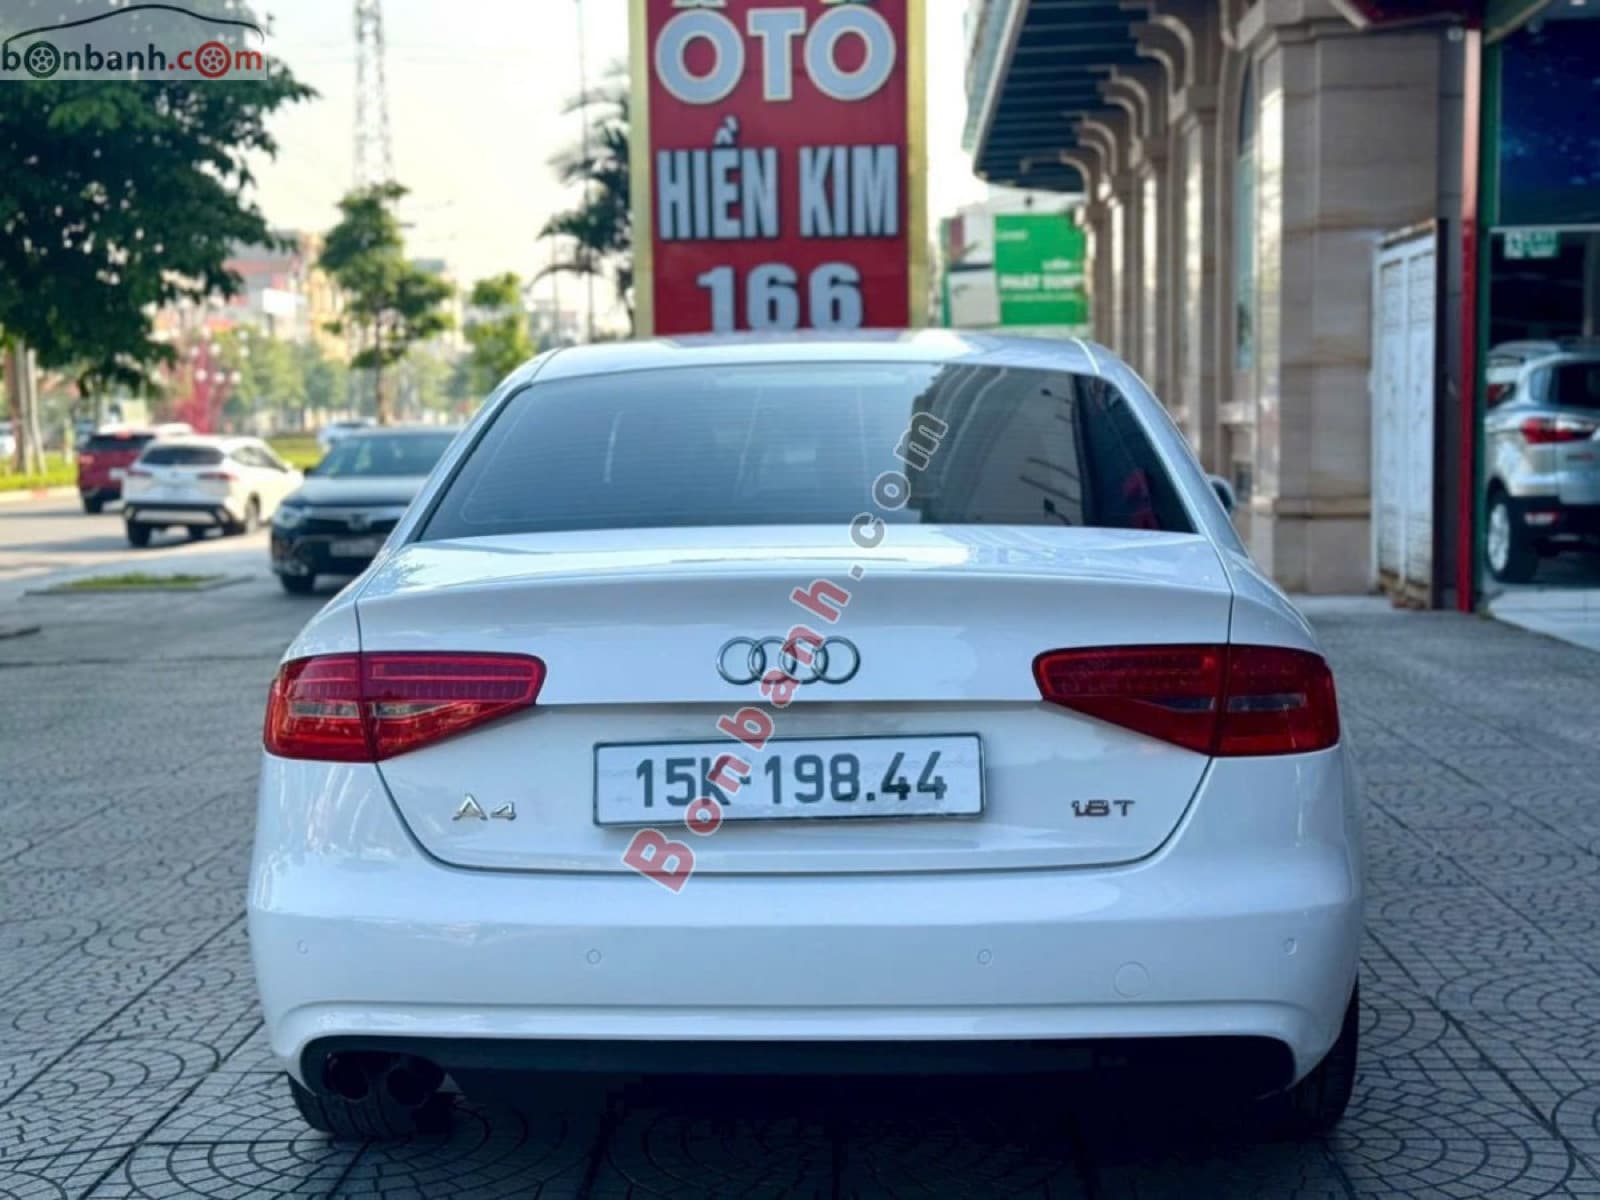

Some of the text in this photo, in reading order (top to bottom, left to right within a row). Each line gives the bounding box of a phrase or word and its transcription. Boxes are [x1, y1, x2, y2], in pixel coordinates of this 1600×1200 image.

[799, 145, 898, 237] KIM
[697, 262, 863, 330] 166
[452, 792, 516, 821] A4
